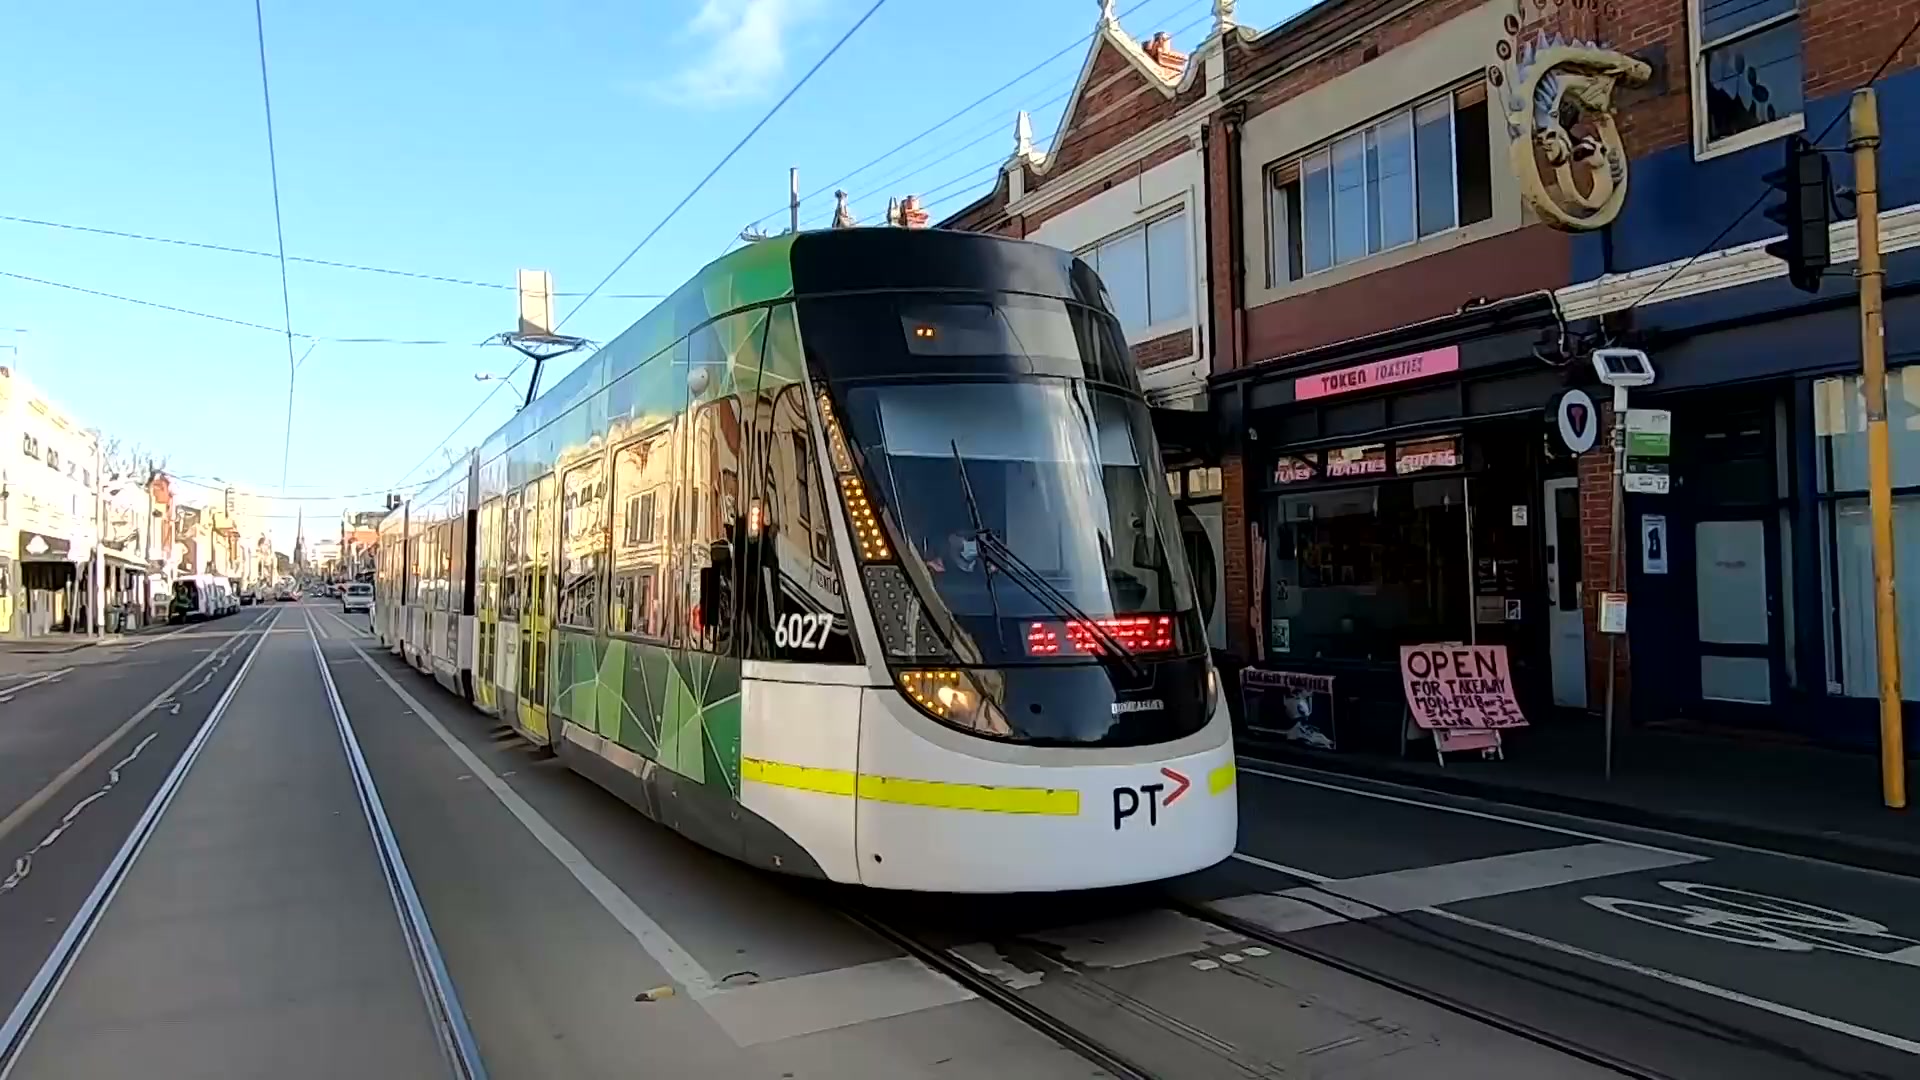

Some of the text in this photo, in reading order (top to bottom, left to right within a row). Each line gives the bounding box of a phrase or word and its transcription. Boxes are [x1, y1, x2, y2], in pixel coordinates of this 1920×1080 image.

[775, 612, 834, 650] 6027
[1407, 650, 1497, 679] OPEN
[1410, 681, 1442, 696] FOR
